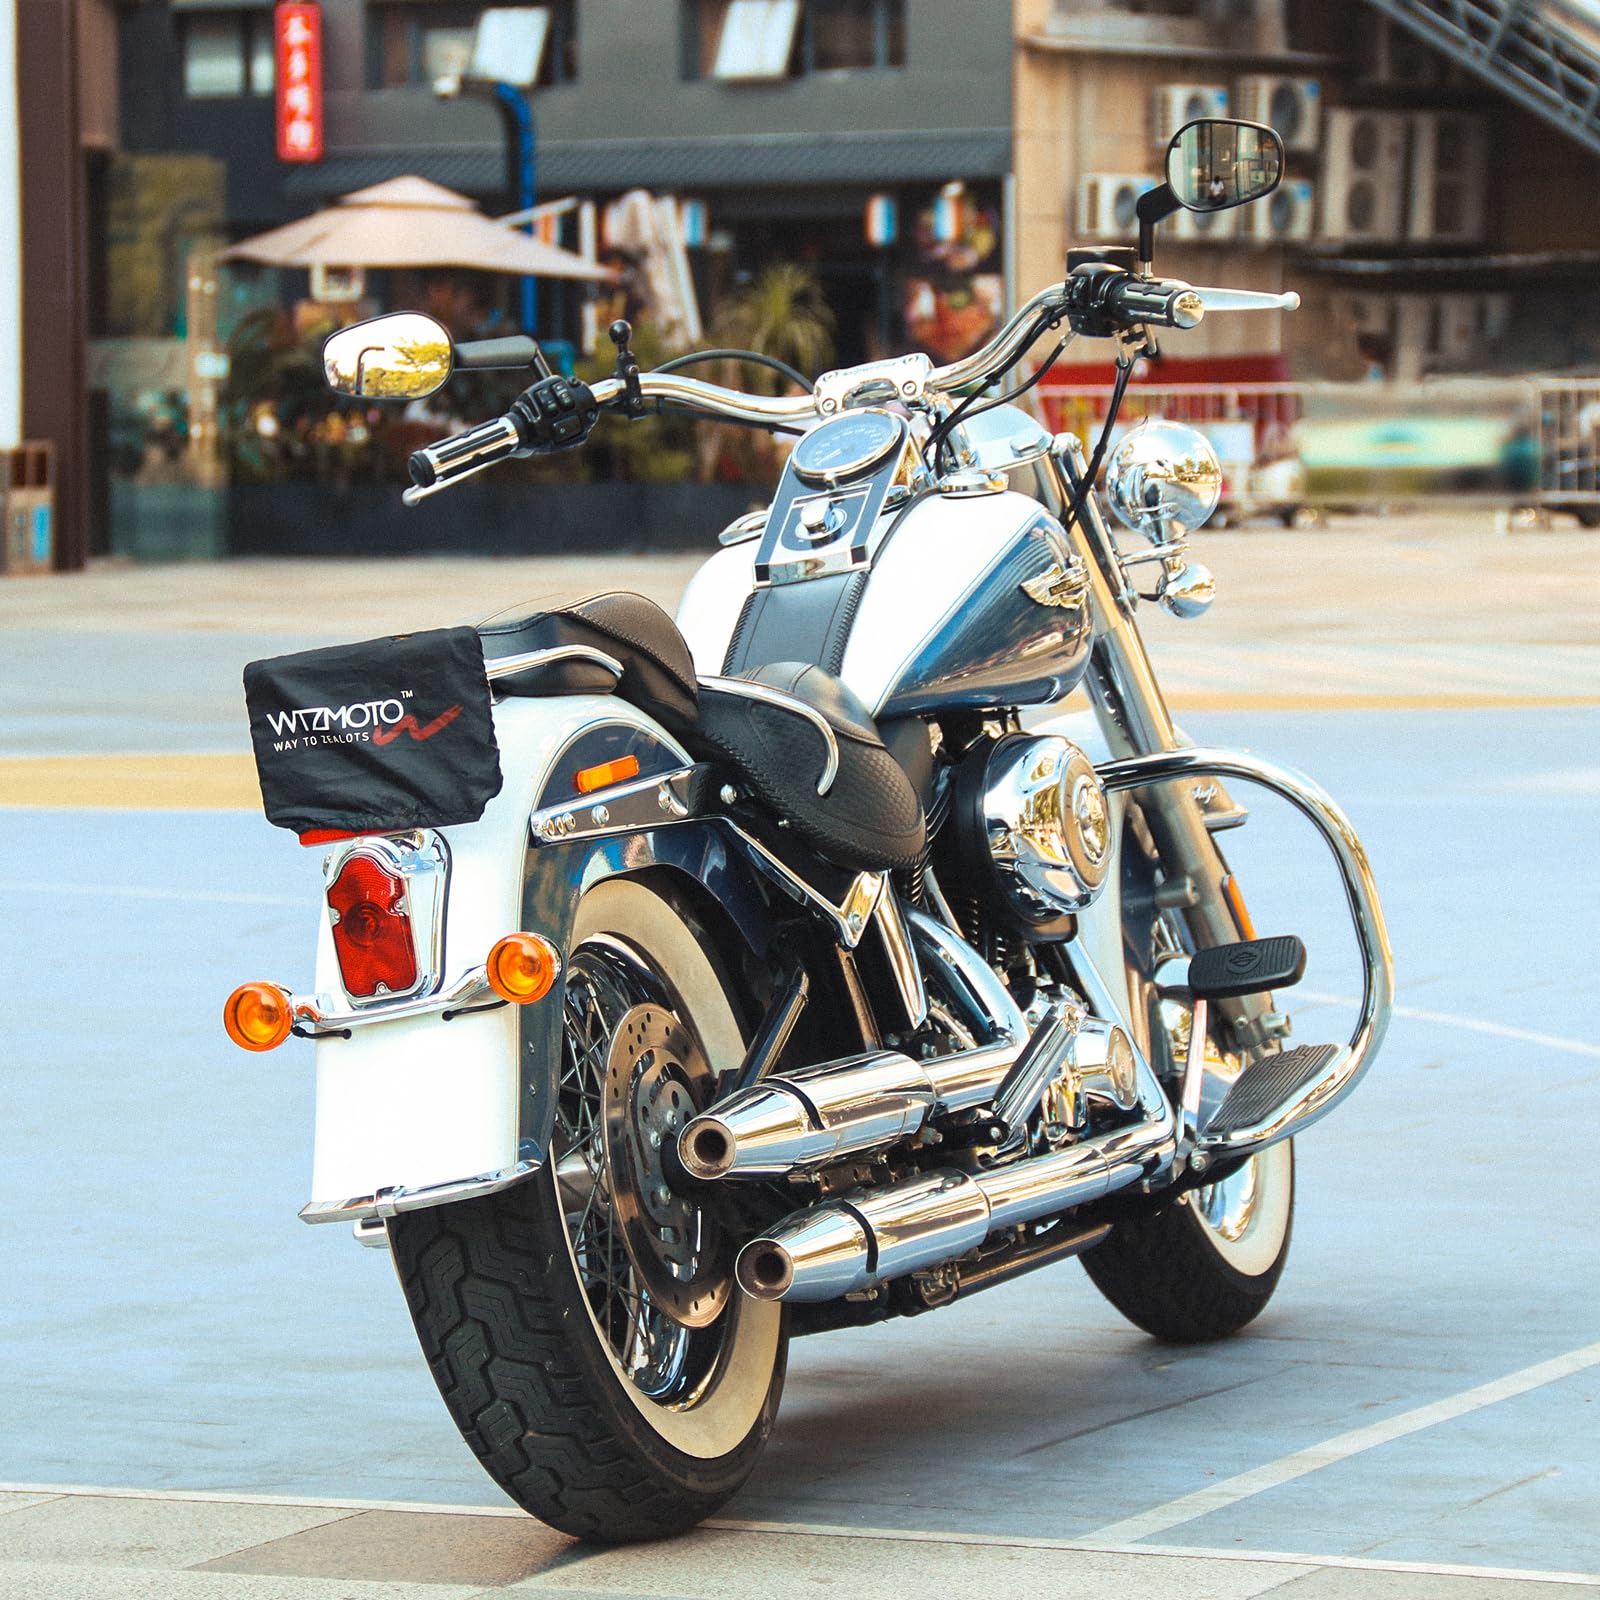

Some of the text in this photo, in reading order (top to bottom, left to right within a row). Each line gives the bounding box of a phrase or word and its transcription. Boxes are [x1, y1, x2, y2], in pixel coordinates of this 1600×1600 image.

[273, 731, 370, 753] WAY TO ZEALOTS
